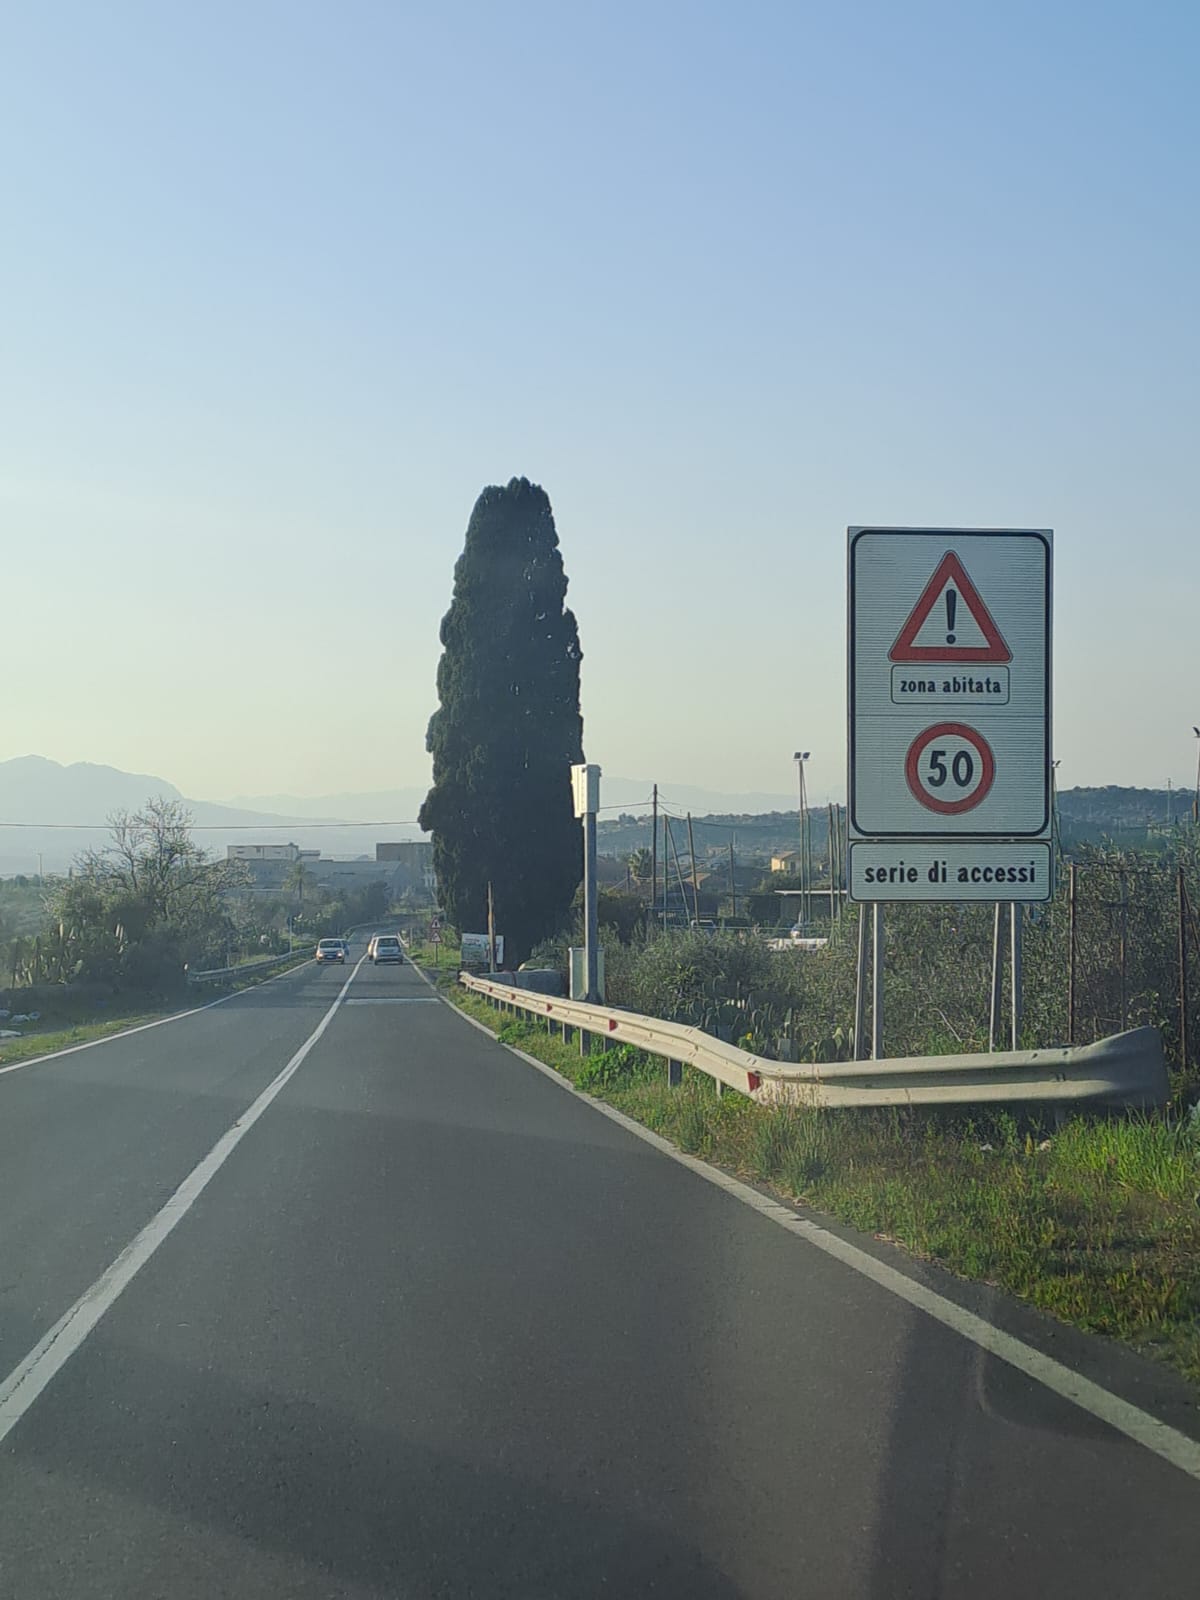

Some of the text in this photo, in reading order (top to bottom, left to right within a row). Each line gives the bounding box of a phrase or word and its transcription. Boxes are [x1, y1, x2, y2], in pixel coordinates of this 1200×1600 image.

[900, 677, 1002, 693] zona abitata
[927, 750, 974, 787] 50
[864, 860, 1036, 883] serie di accessi
